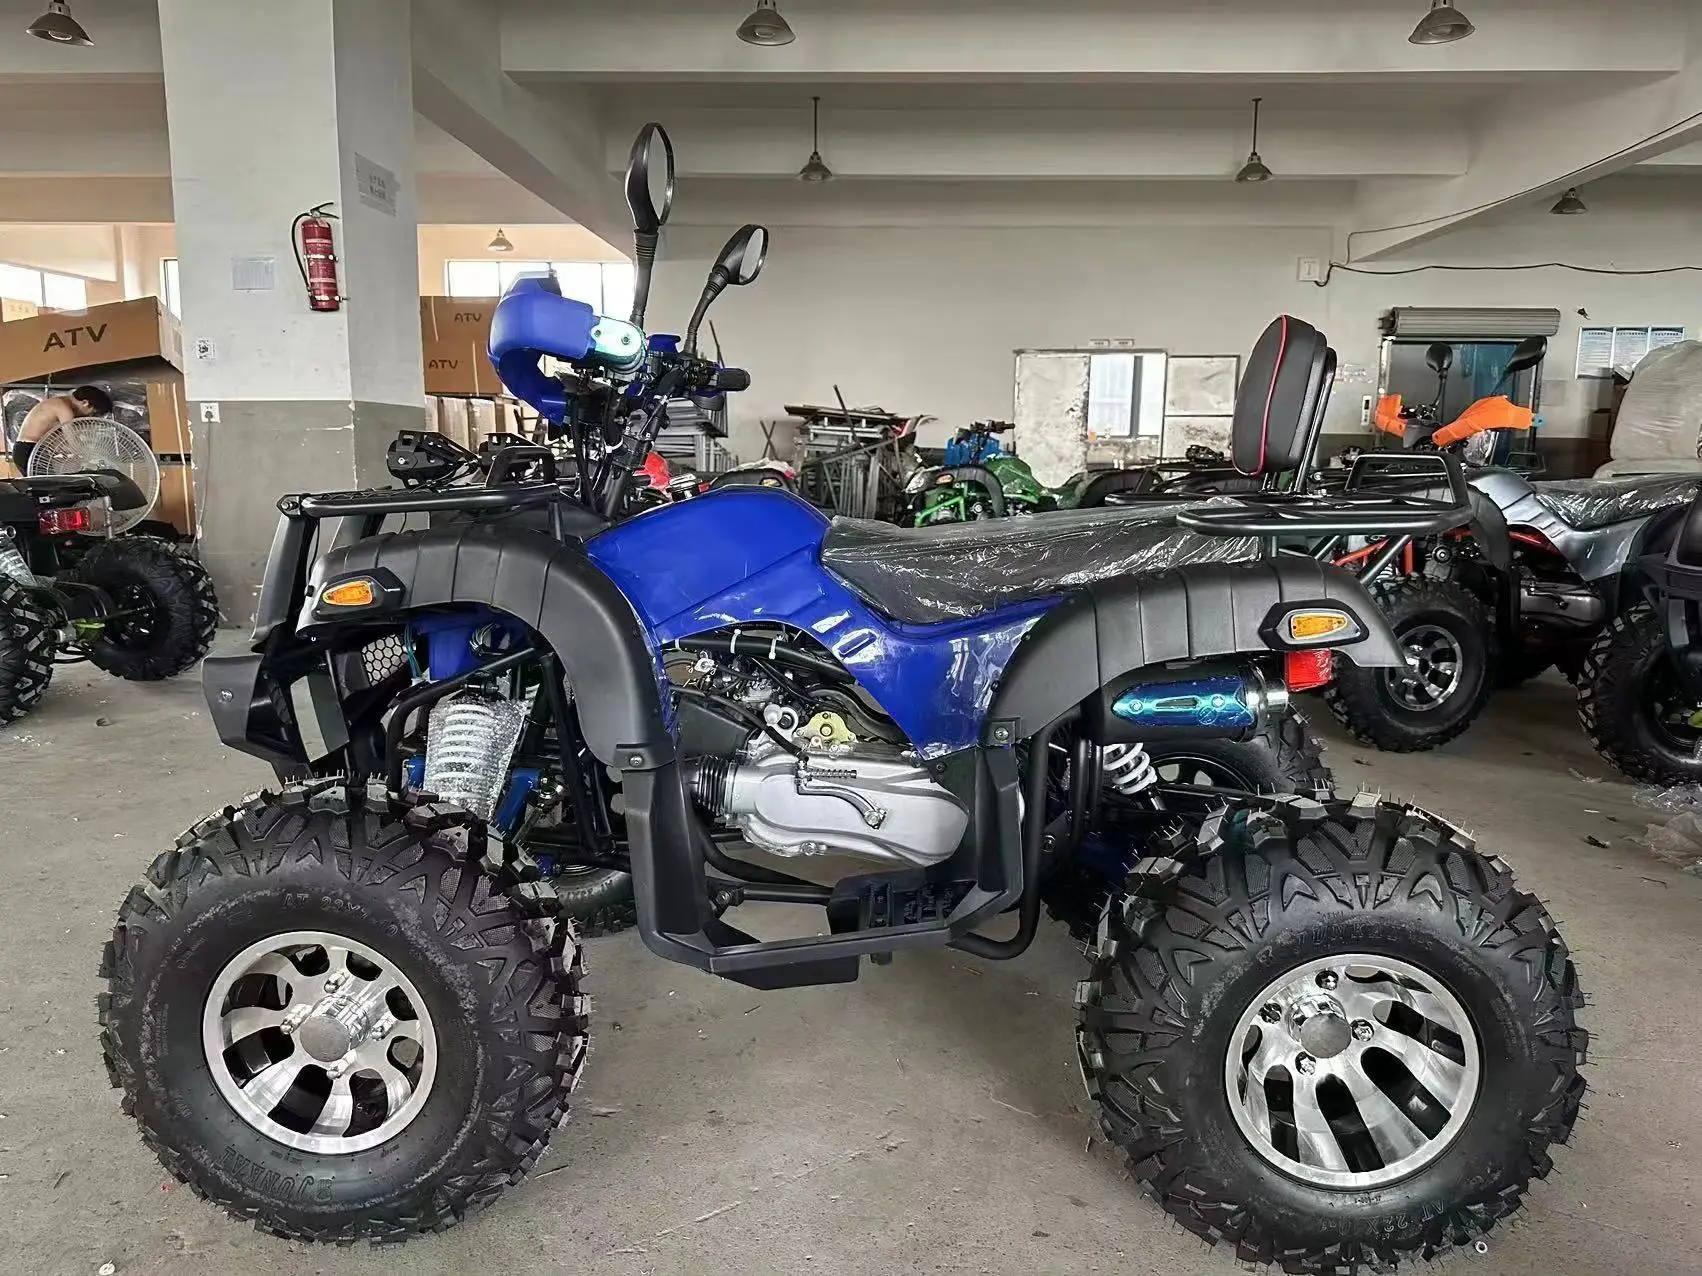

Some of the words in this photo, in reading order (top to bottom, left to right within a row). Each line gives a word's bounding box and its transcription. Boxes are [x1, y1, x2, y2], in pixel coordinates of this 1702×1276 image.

[454, 312, 482, 323] ATV
[43, 324, 108, 353] ATV
[428, 359, 459, 370] ATV
